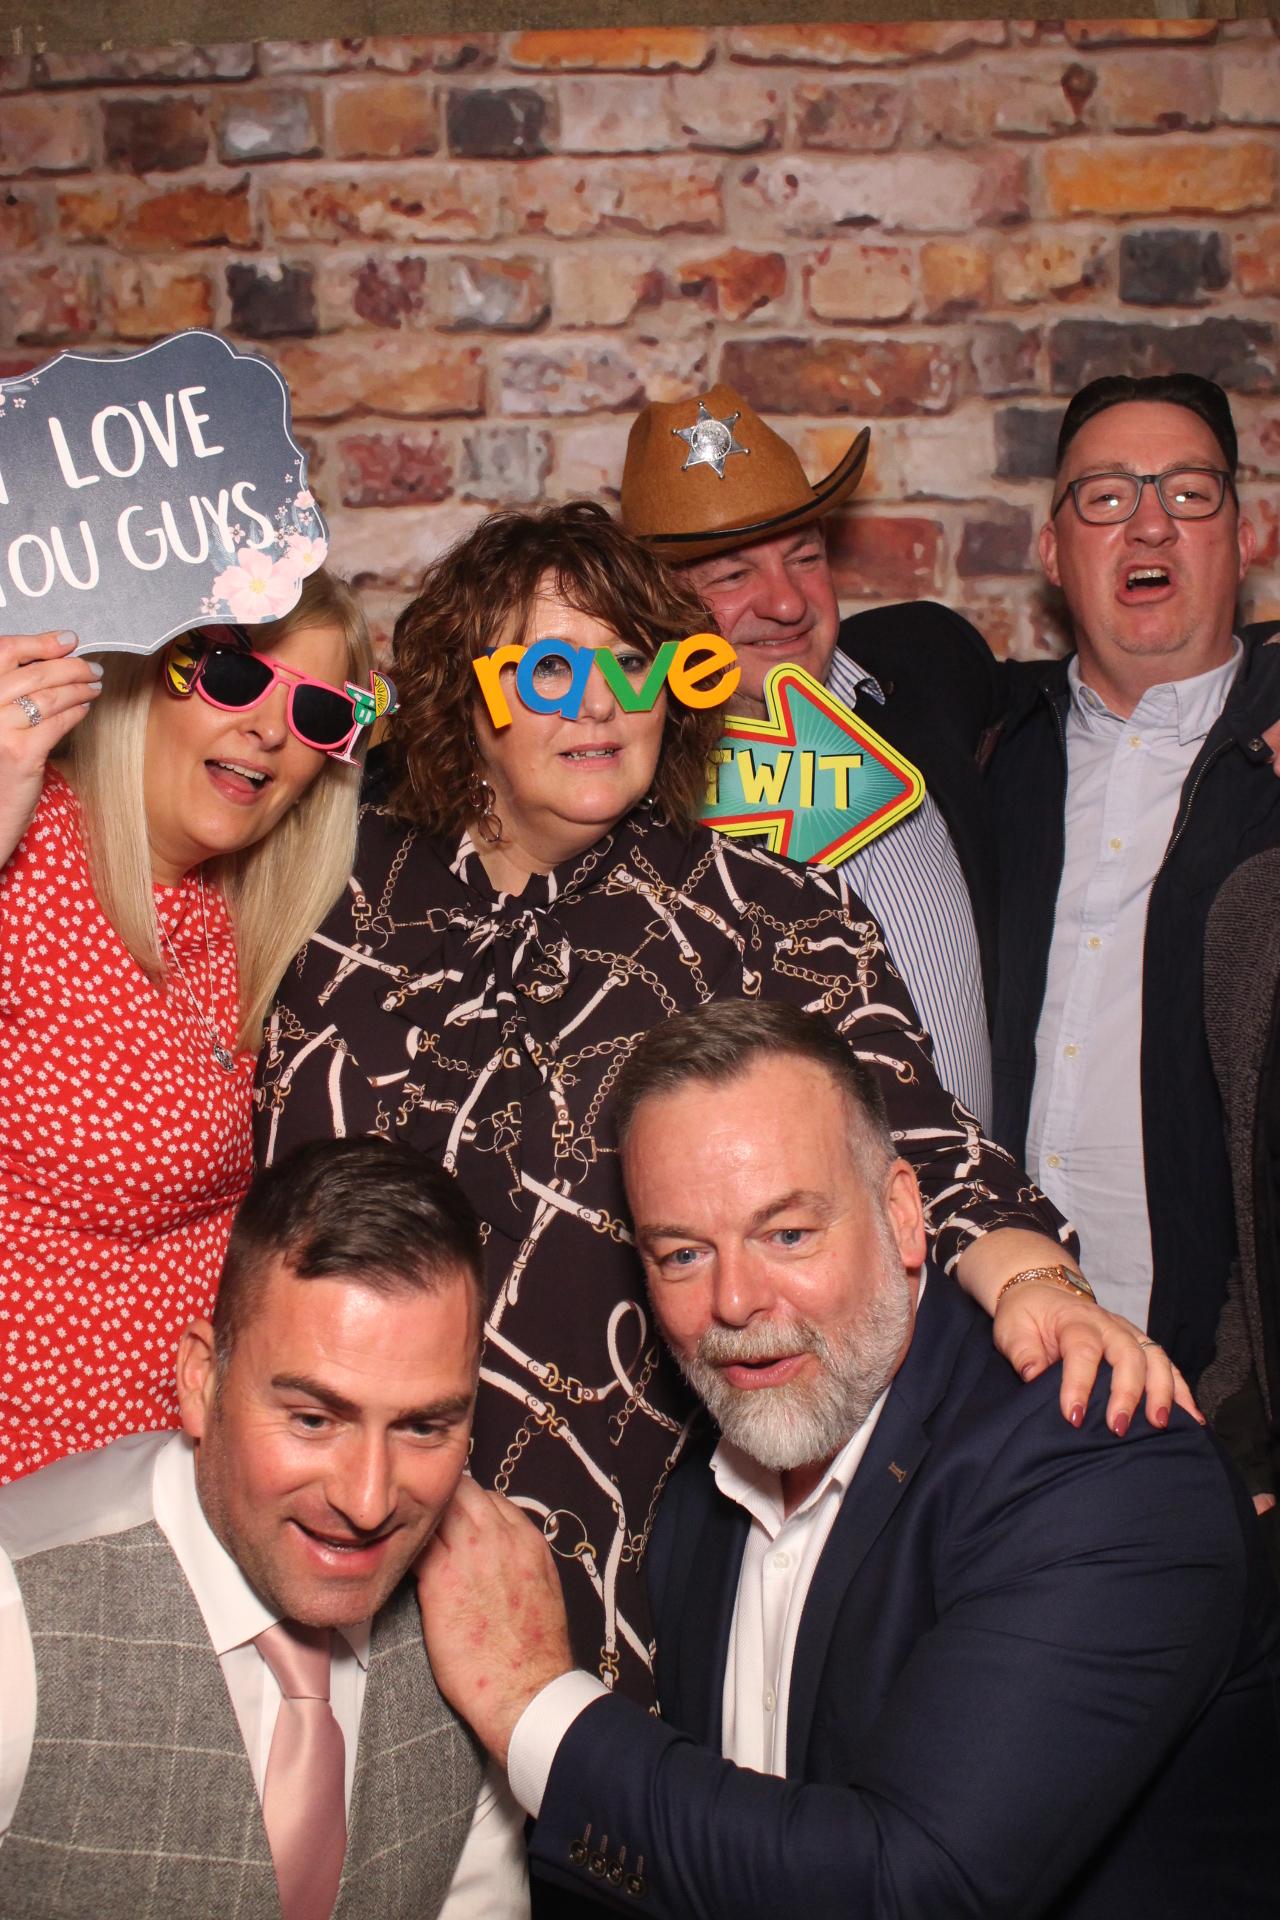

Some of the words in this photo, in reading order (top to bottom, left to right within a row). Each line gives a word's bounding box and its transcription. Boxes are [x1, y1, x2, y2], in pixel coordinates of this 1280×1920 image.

[48, 386, 224, 489] LOVE
[0, 520, 99, 607] OU
[117, 481, 275, 571] GUYS
[472, 633, 742, 729] rave
